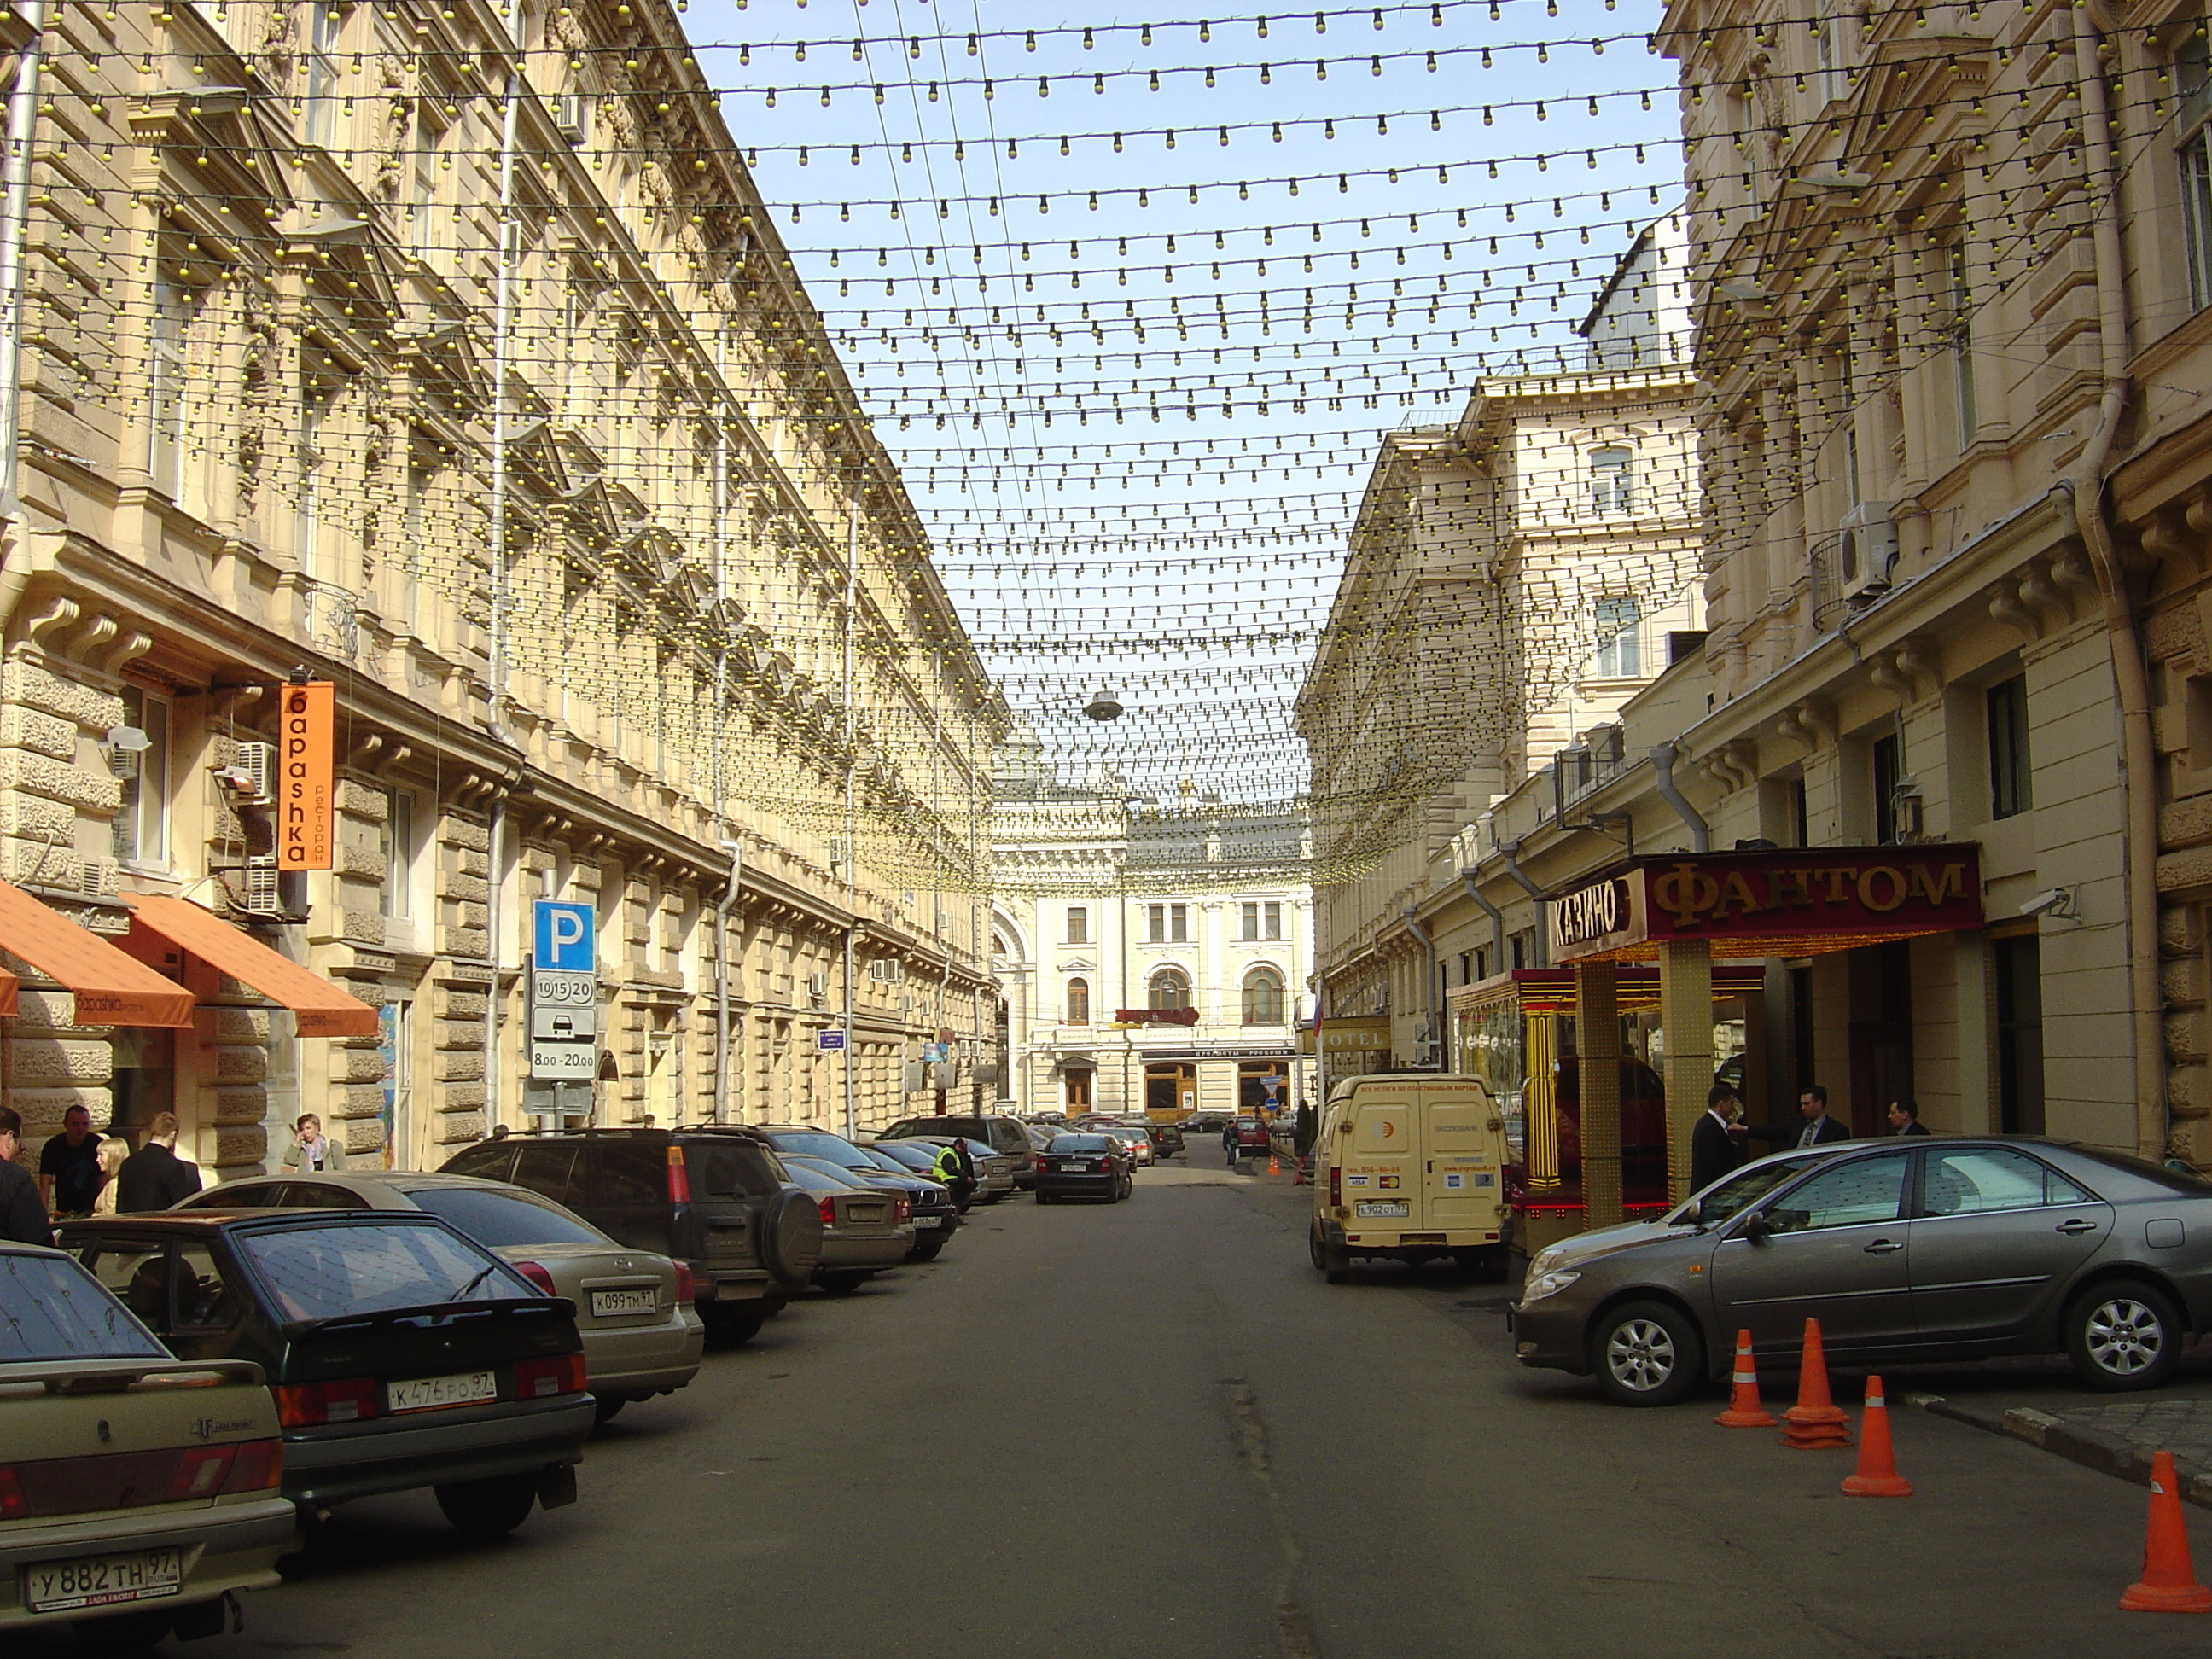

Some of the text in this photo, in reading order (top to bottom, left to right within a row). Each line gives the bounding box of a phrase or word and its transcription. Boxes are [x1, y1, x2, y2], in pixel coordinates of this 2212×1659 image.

[314, 784, 324, 862] ресторан
[1556, 878, 1621, 947] КАЗИНО
[1654, 862, 1968, 928] ФАНТОМ
[539, 981, 589, 996] 10 15 20
[534, 1053, 556, 1066] 8.00
[564, 1053, 593, 1068] 20.00
[148, 1553, 172, 1575] 97
